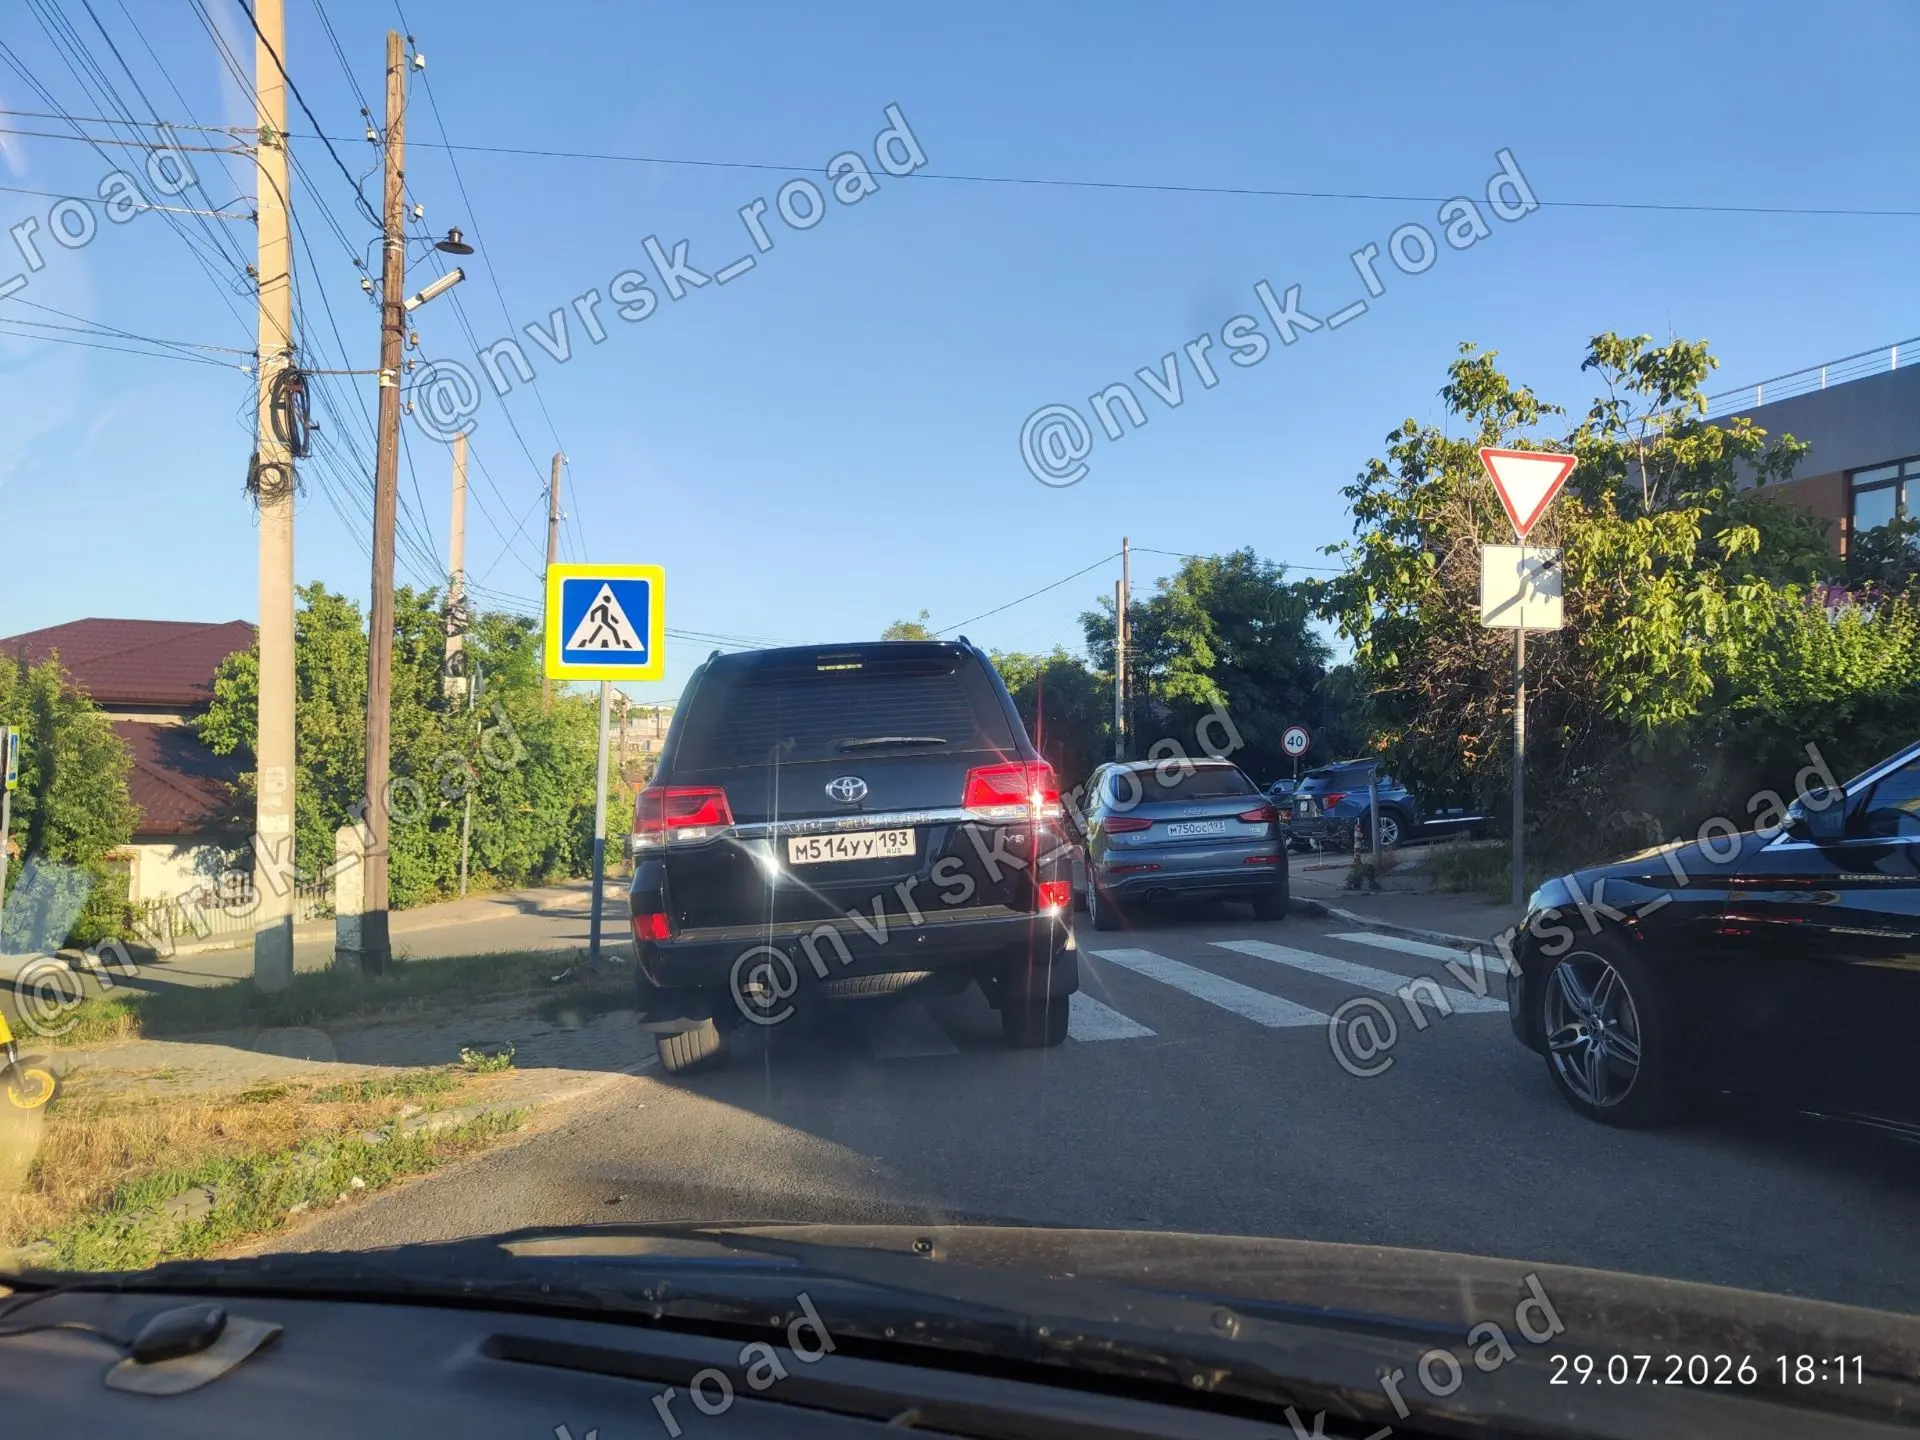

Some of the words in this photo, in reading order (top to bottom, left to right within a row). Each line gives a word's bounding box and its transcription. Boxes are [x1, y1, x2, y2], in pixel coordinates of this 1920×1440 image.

[1287, 735, 1304, 748] 40
[1209, 821, 1224, 831] 193
[878, 831, 909, 848] 193
